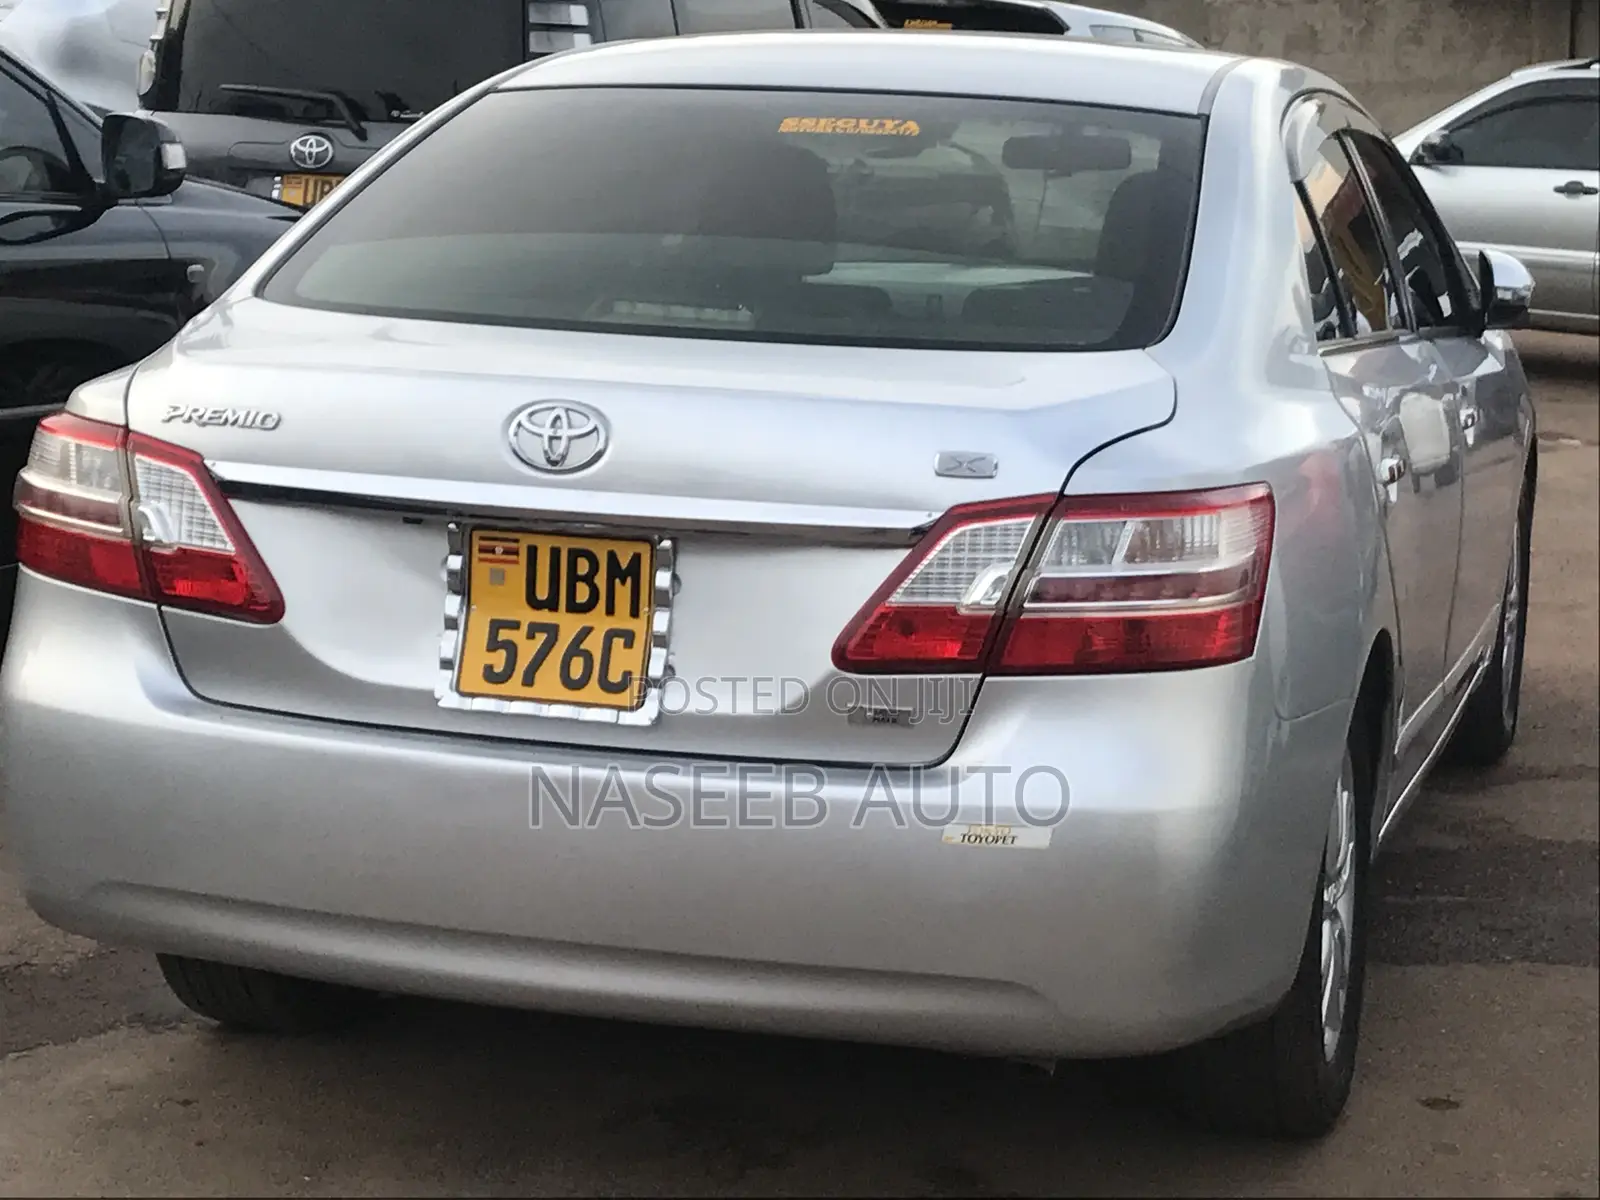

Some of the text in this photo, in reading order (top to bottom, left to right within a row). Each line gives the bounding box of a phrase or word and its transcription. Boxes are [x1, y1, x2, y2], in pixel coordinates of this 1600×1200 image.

[161, 404, 282, 431] PREMIO
[525, 544, 642, 618] UBM
[482, 618, 636, 694] 576C
[960, 832, 1018, 845] TOYOPET
